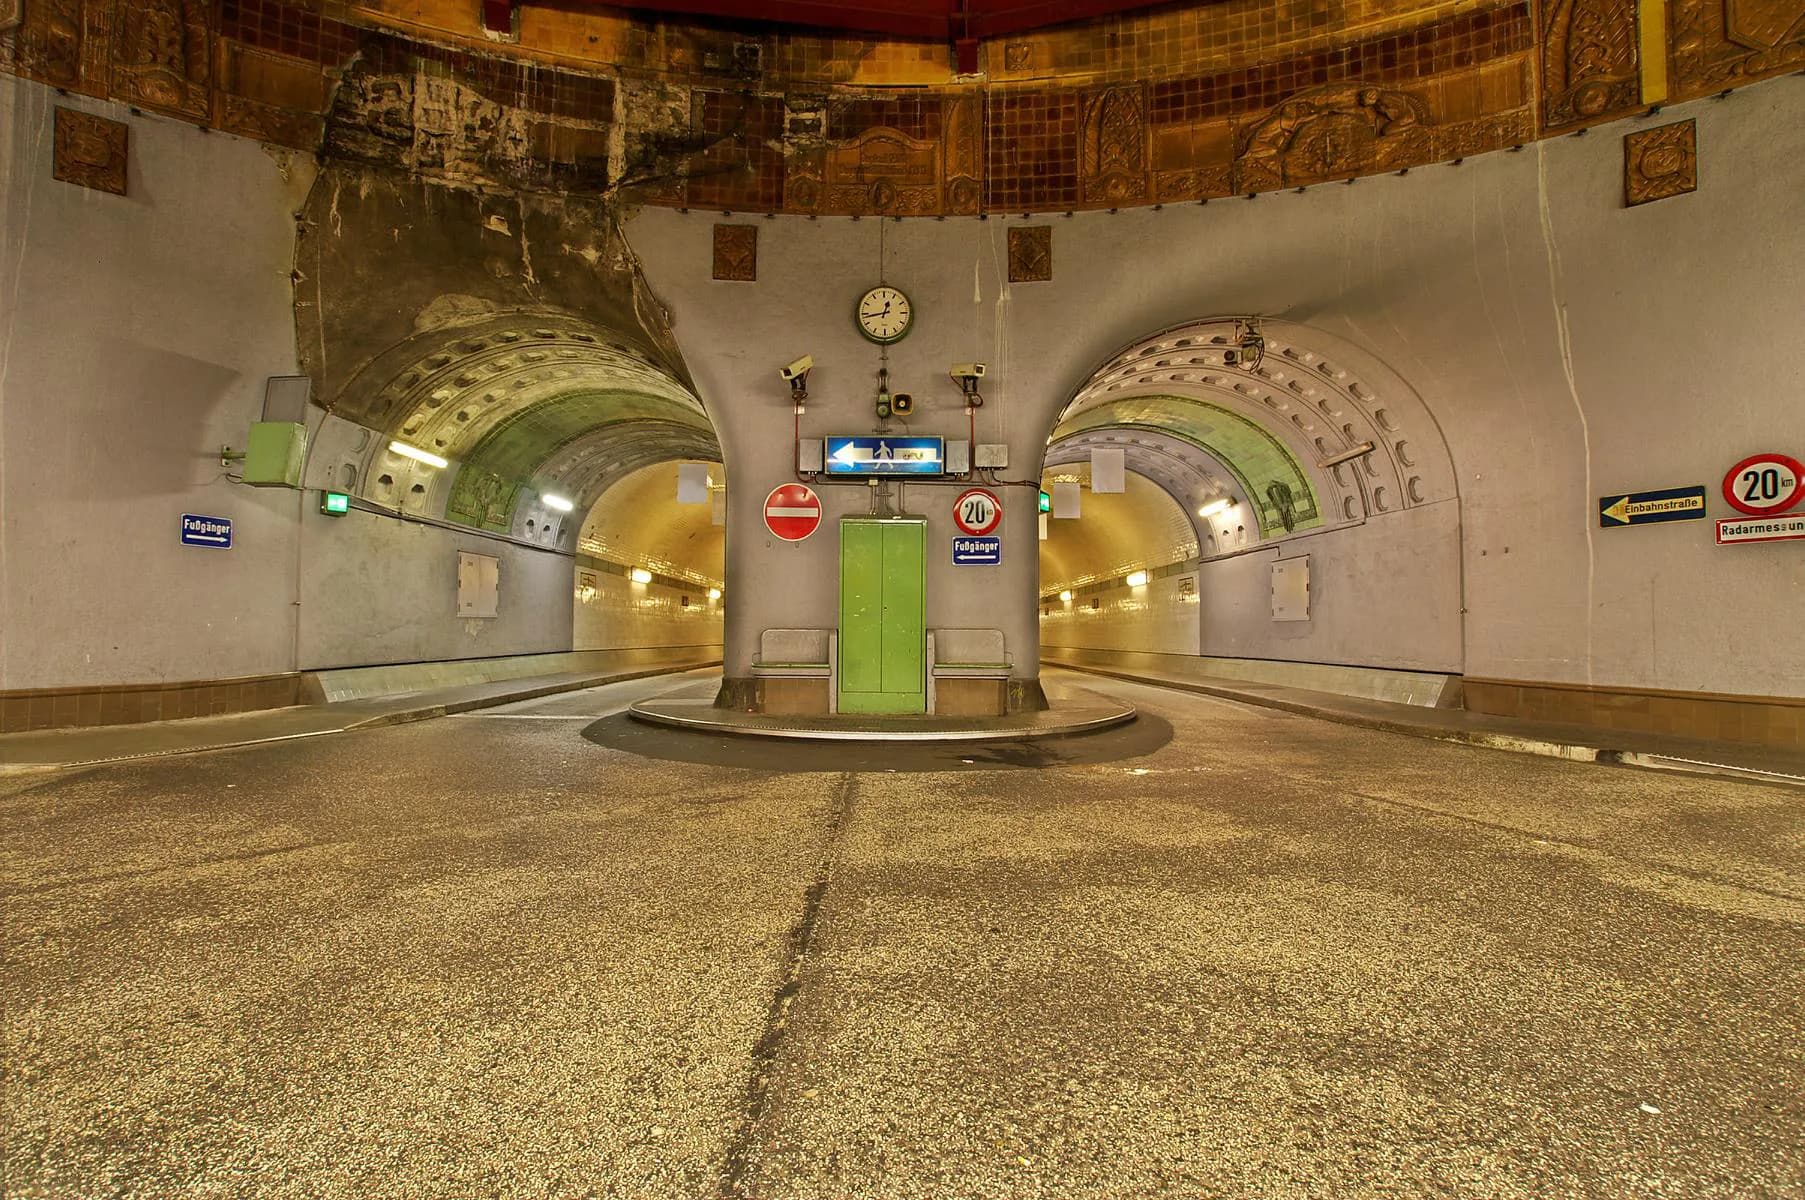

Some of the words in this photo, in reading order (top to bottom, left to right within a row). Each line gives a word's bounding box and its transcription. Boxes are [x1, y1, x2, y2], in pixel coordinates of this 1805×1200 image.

[1743, 469, 1778, 501] 20
[1781, 477, 1794, 488] km
[965, 500, 985, 523] 20
[1625, 498, 1698, 514] Einbahnstraße
[184, 519, 230, 534] Fußgänger
[955, 541, 998, 552] Fußgänger
